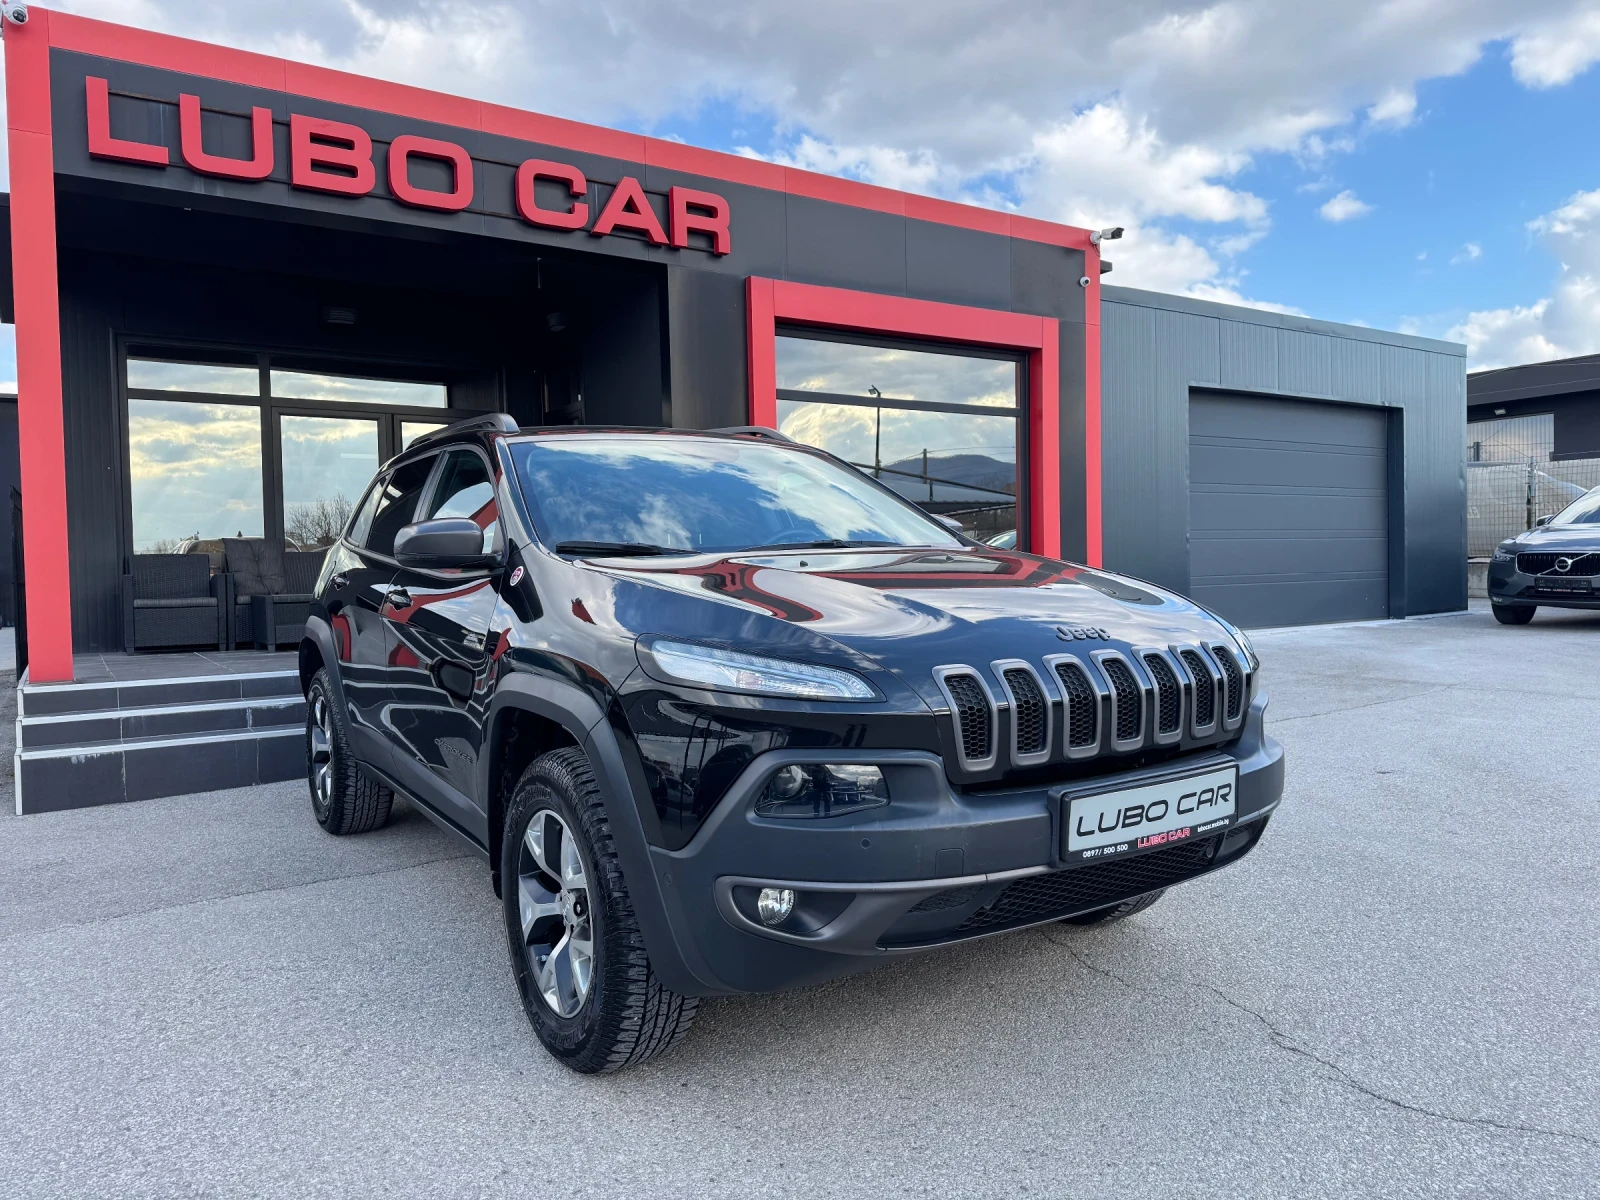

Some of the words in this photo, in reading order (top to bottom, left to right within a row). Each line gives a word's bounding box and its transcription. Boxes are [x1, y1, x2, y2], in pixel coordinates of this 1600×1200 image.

[85, 75, 474, 213] LUBO
[514, 158, 731, 256] CAR
[1056, 626, 1110, 641] Jeep
[1076, 799, 1169, 838] LUBO
[1176, 782, 1232, 816] CAR
[1137, 833, 1169, 848] LUBO
[1168, 827, 1191, 841] CAR
[1082, 848, 1102, 859] 0897/
[1103, 845, 1116, 855] 500
[1116, 843, 1129, 852] 500
